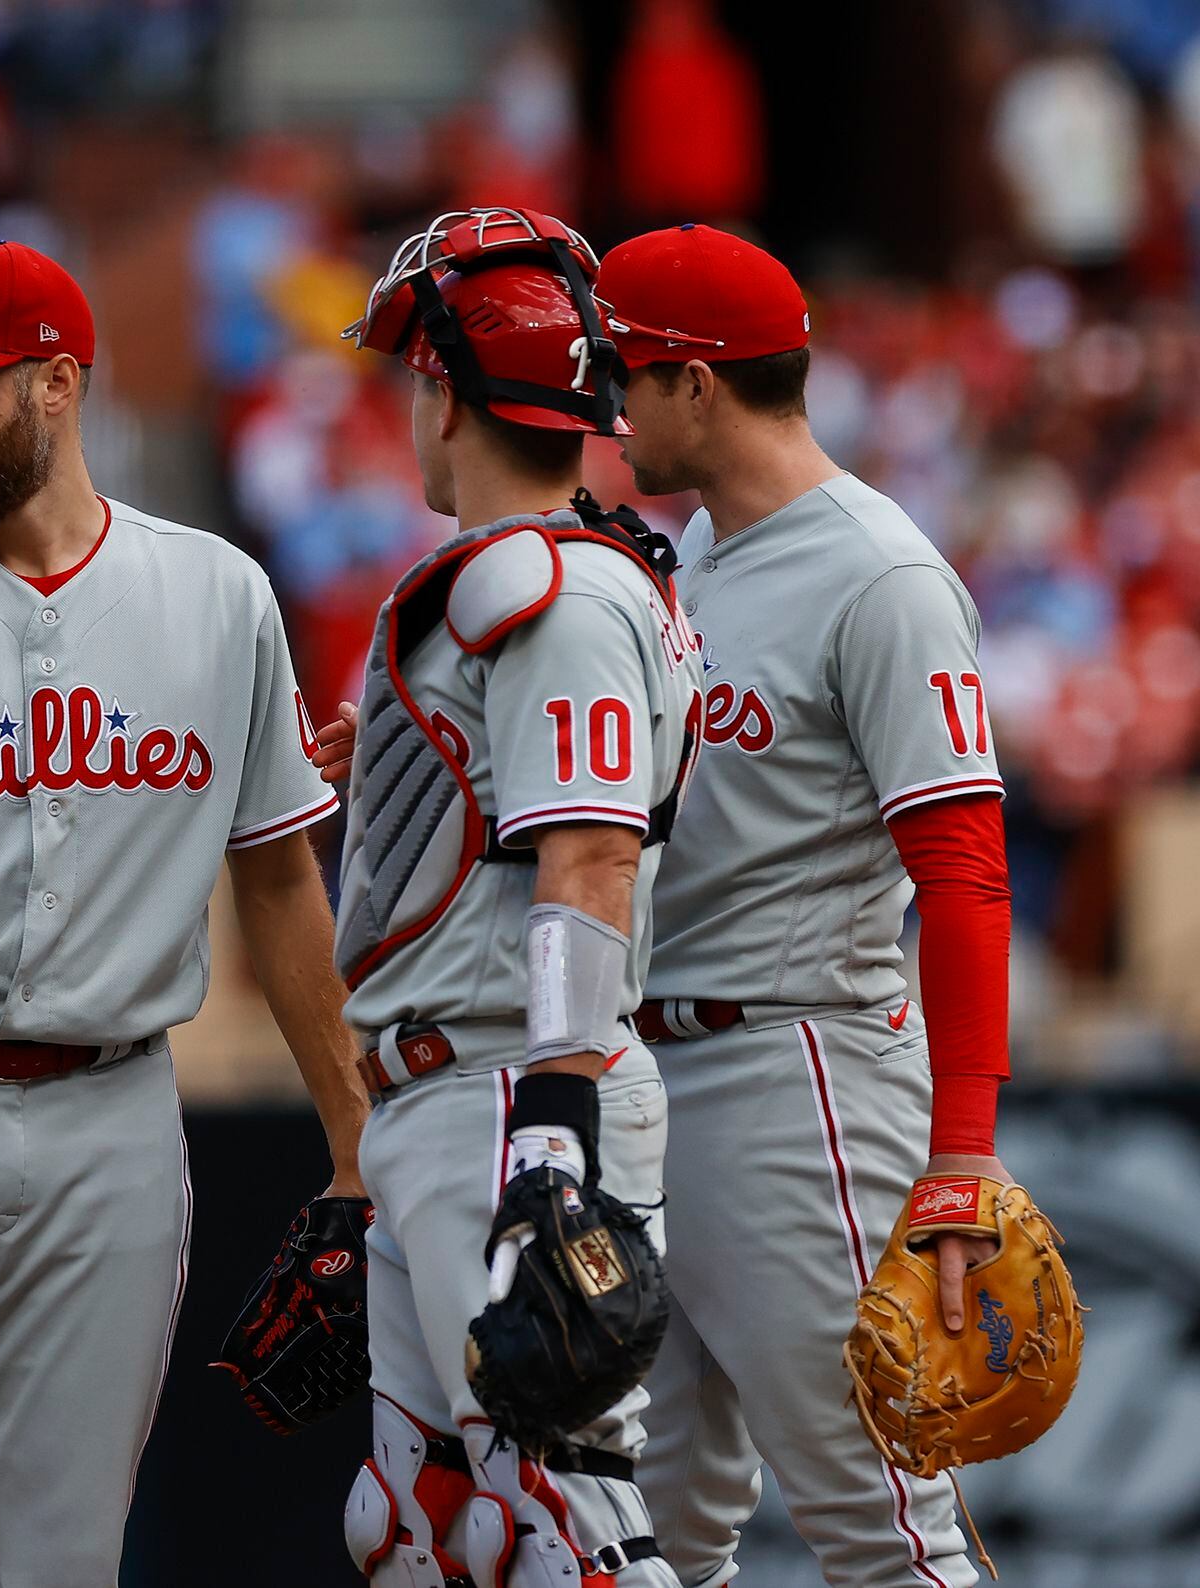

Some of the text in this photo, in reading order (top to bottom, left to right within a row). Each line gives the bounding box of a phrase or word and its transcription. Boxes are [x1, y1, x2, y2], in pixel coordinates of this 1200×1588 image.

[543, 694, 635, 786] 10
[927, 669, 989, 758] 17
[413, 1043, 432, 1064] 10
[915, 1188, 973, 1213] Rawlings
[977, 1289, 1014, 1373] Rawlings
